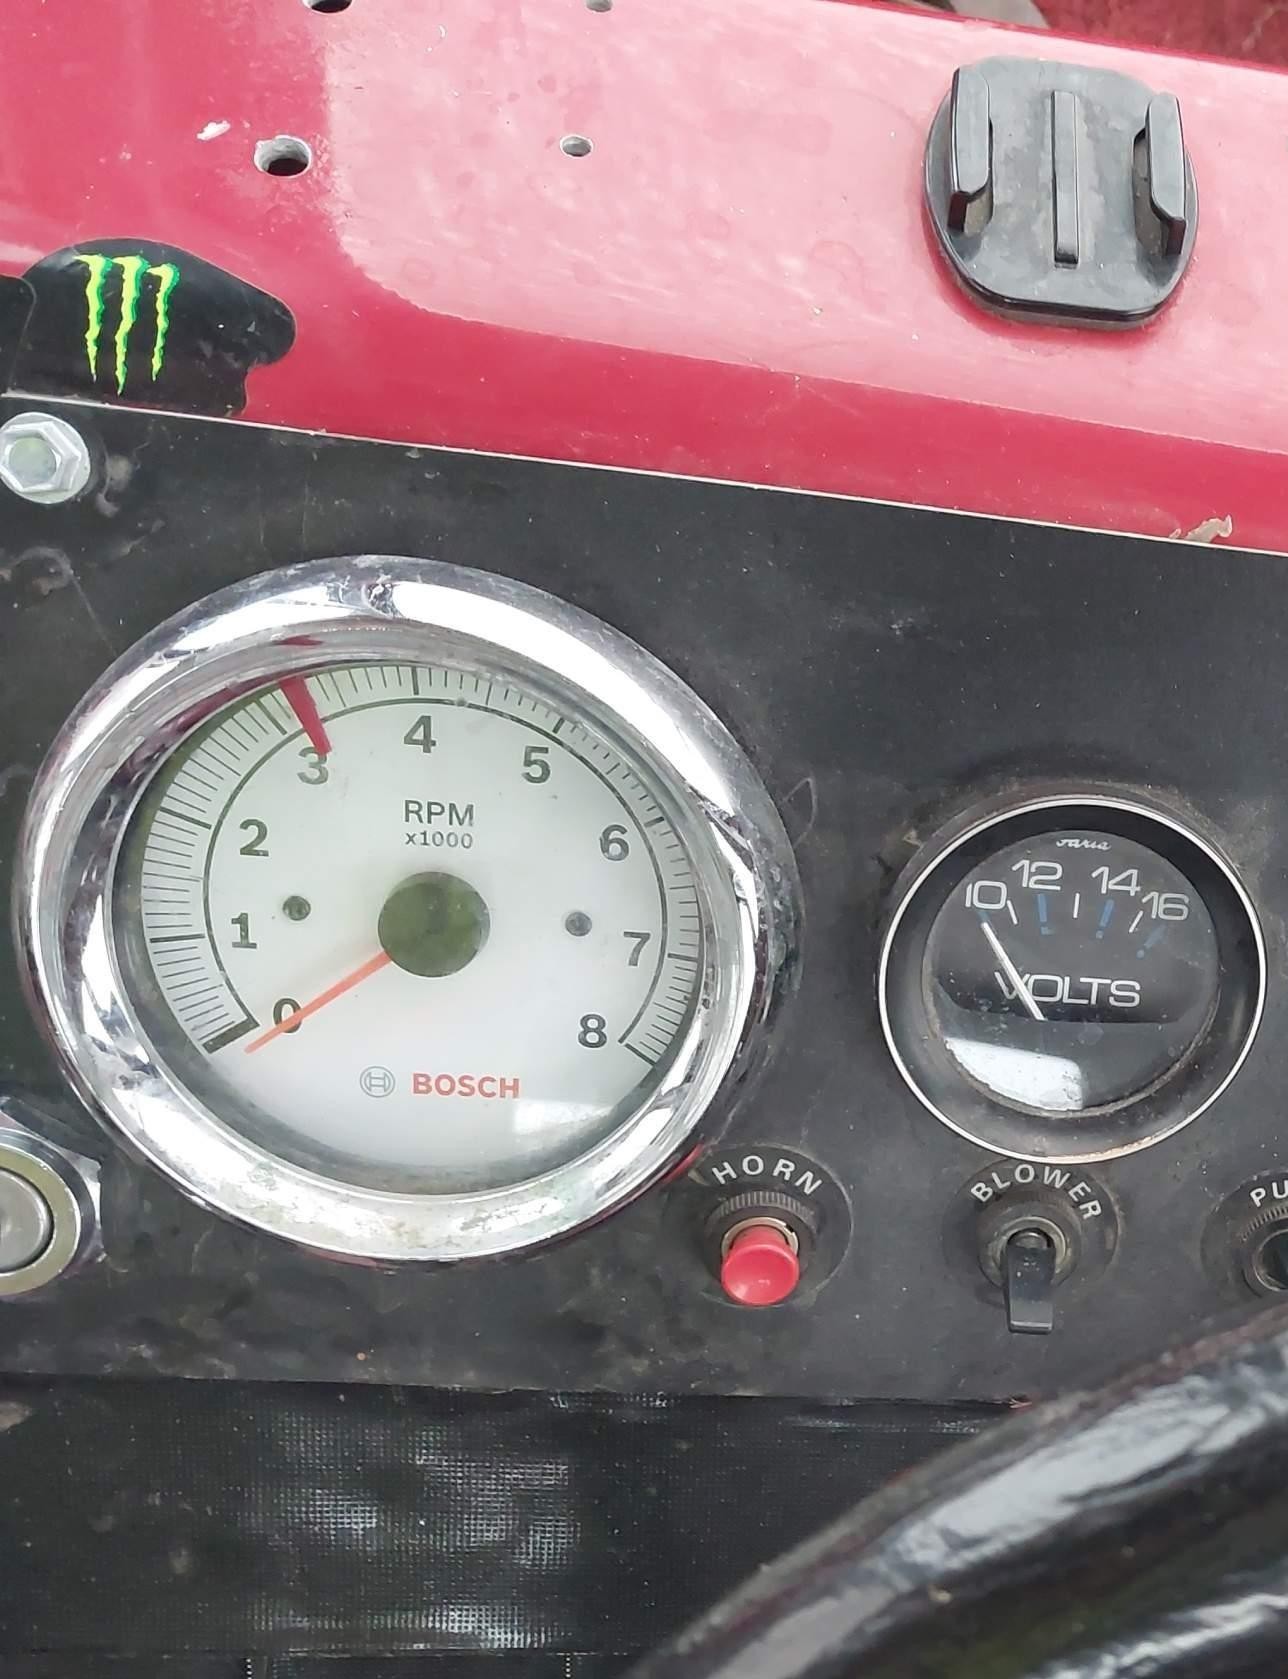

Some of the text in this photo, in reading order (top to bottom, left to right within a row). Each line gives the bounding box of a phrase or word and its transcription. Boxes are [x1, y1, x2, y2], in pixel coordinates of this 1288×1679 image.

[403, 715, 437, 753] 4
[296, 745, 330, 785] 3
[522, 745, 552, 784] 5
[403, 799, 475, 827] RPM
[238, 819, 270, 858] 2
[404, 830, 474, 850] x1000
[599, 824, 631, 862] 6
[1011, 859, 1063, 891] 12
[1091, 866, 1141, 896] 14
[964, 880, 1008, 910] 10
[1141, 891, 1190, 921] 16
[230, 912, 258, 950] 1
[623, 931, 652, 967] 7
[994, 970, 1141, 1008] VOLTS
[272, 998, 303, 1034] 0
[577, 1013, 608, 1050] 8
[411, 1072, 521, 1100] BOSCH
[711, 1155, 823, 1197] HORN
[969, 1162, 1102, 1220] BLOWER
